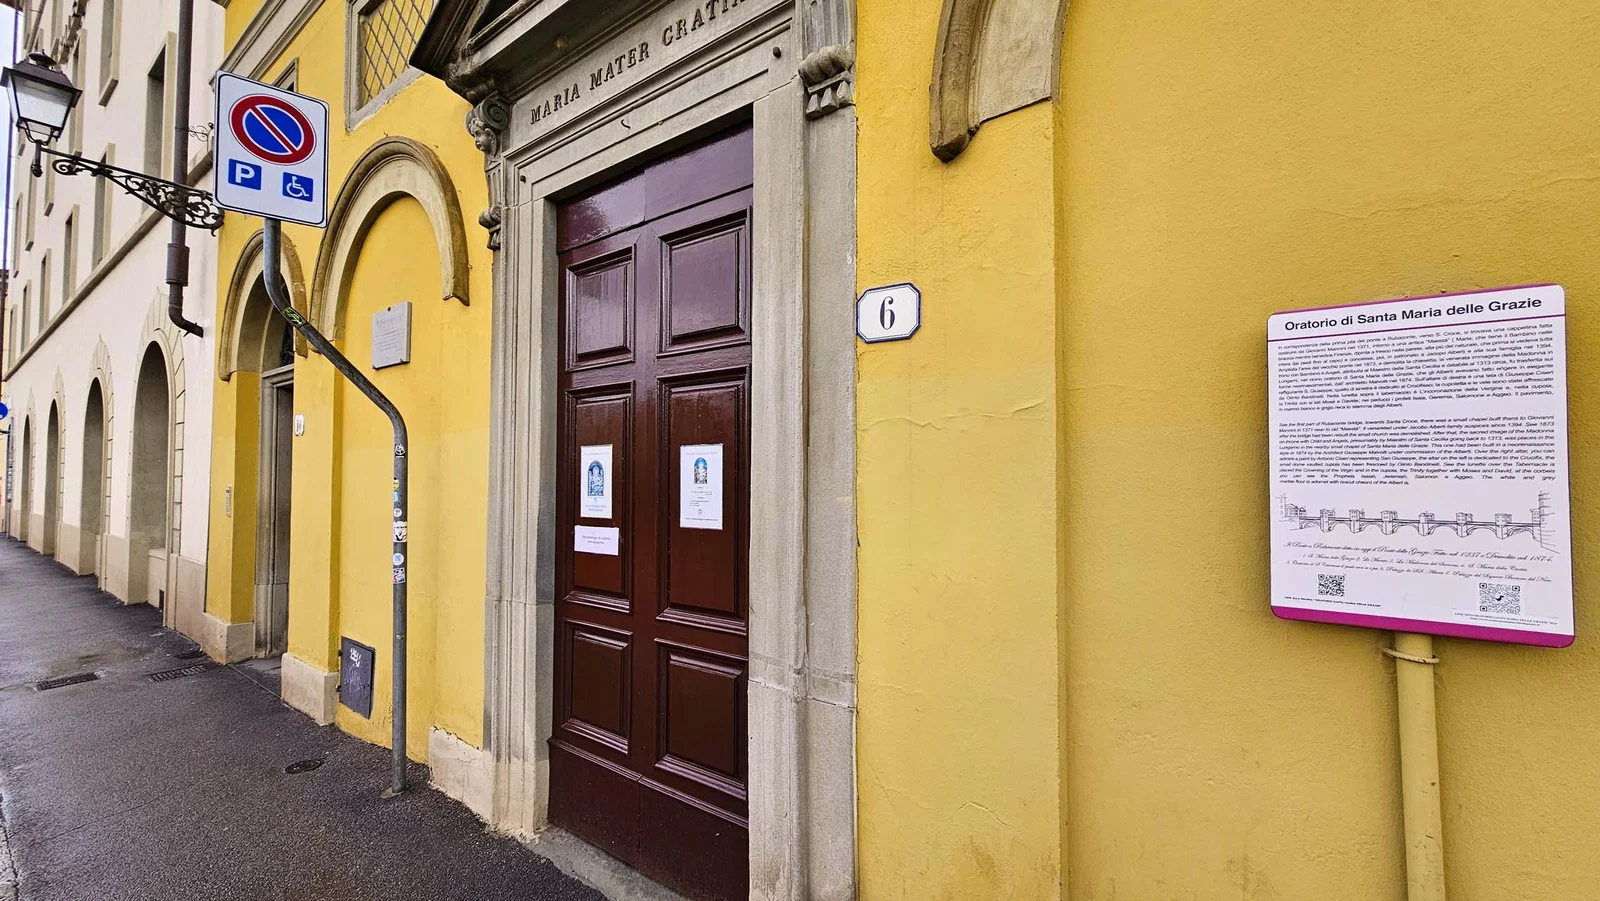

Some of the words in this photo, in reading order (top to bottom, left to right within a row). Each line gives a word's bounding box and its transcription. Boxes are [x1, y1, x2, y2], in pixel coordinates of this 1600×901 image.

[530, 83, 580, 125] MARIA
[589, 41, 650, 91] MATER
[235, 162, 255, 184] P
[879, 295, 896, 331] 6
[1284, 317, 1338, 331] Oratorio
[1340, 315, 1354, 326] di
[1357, 311, 1398, 325] Santa
[1401, 308, 1443, 321] Maria
[1446, 303, 1485, 317] delle
[1488, 297, 1543, 312] Grazie
